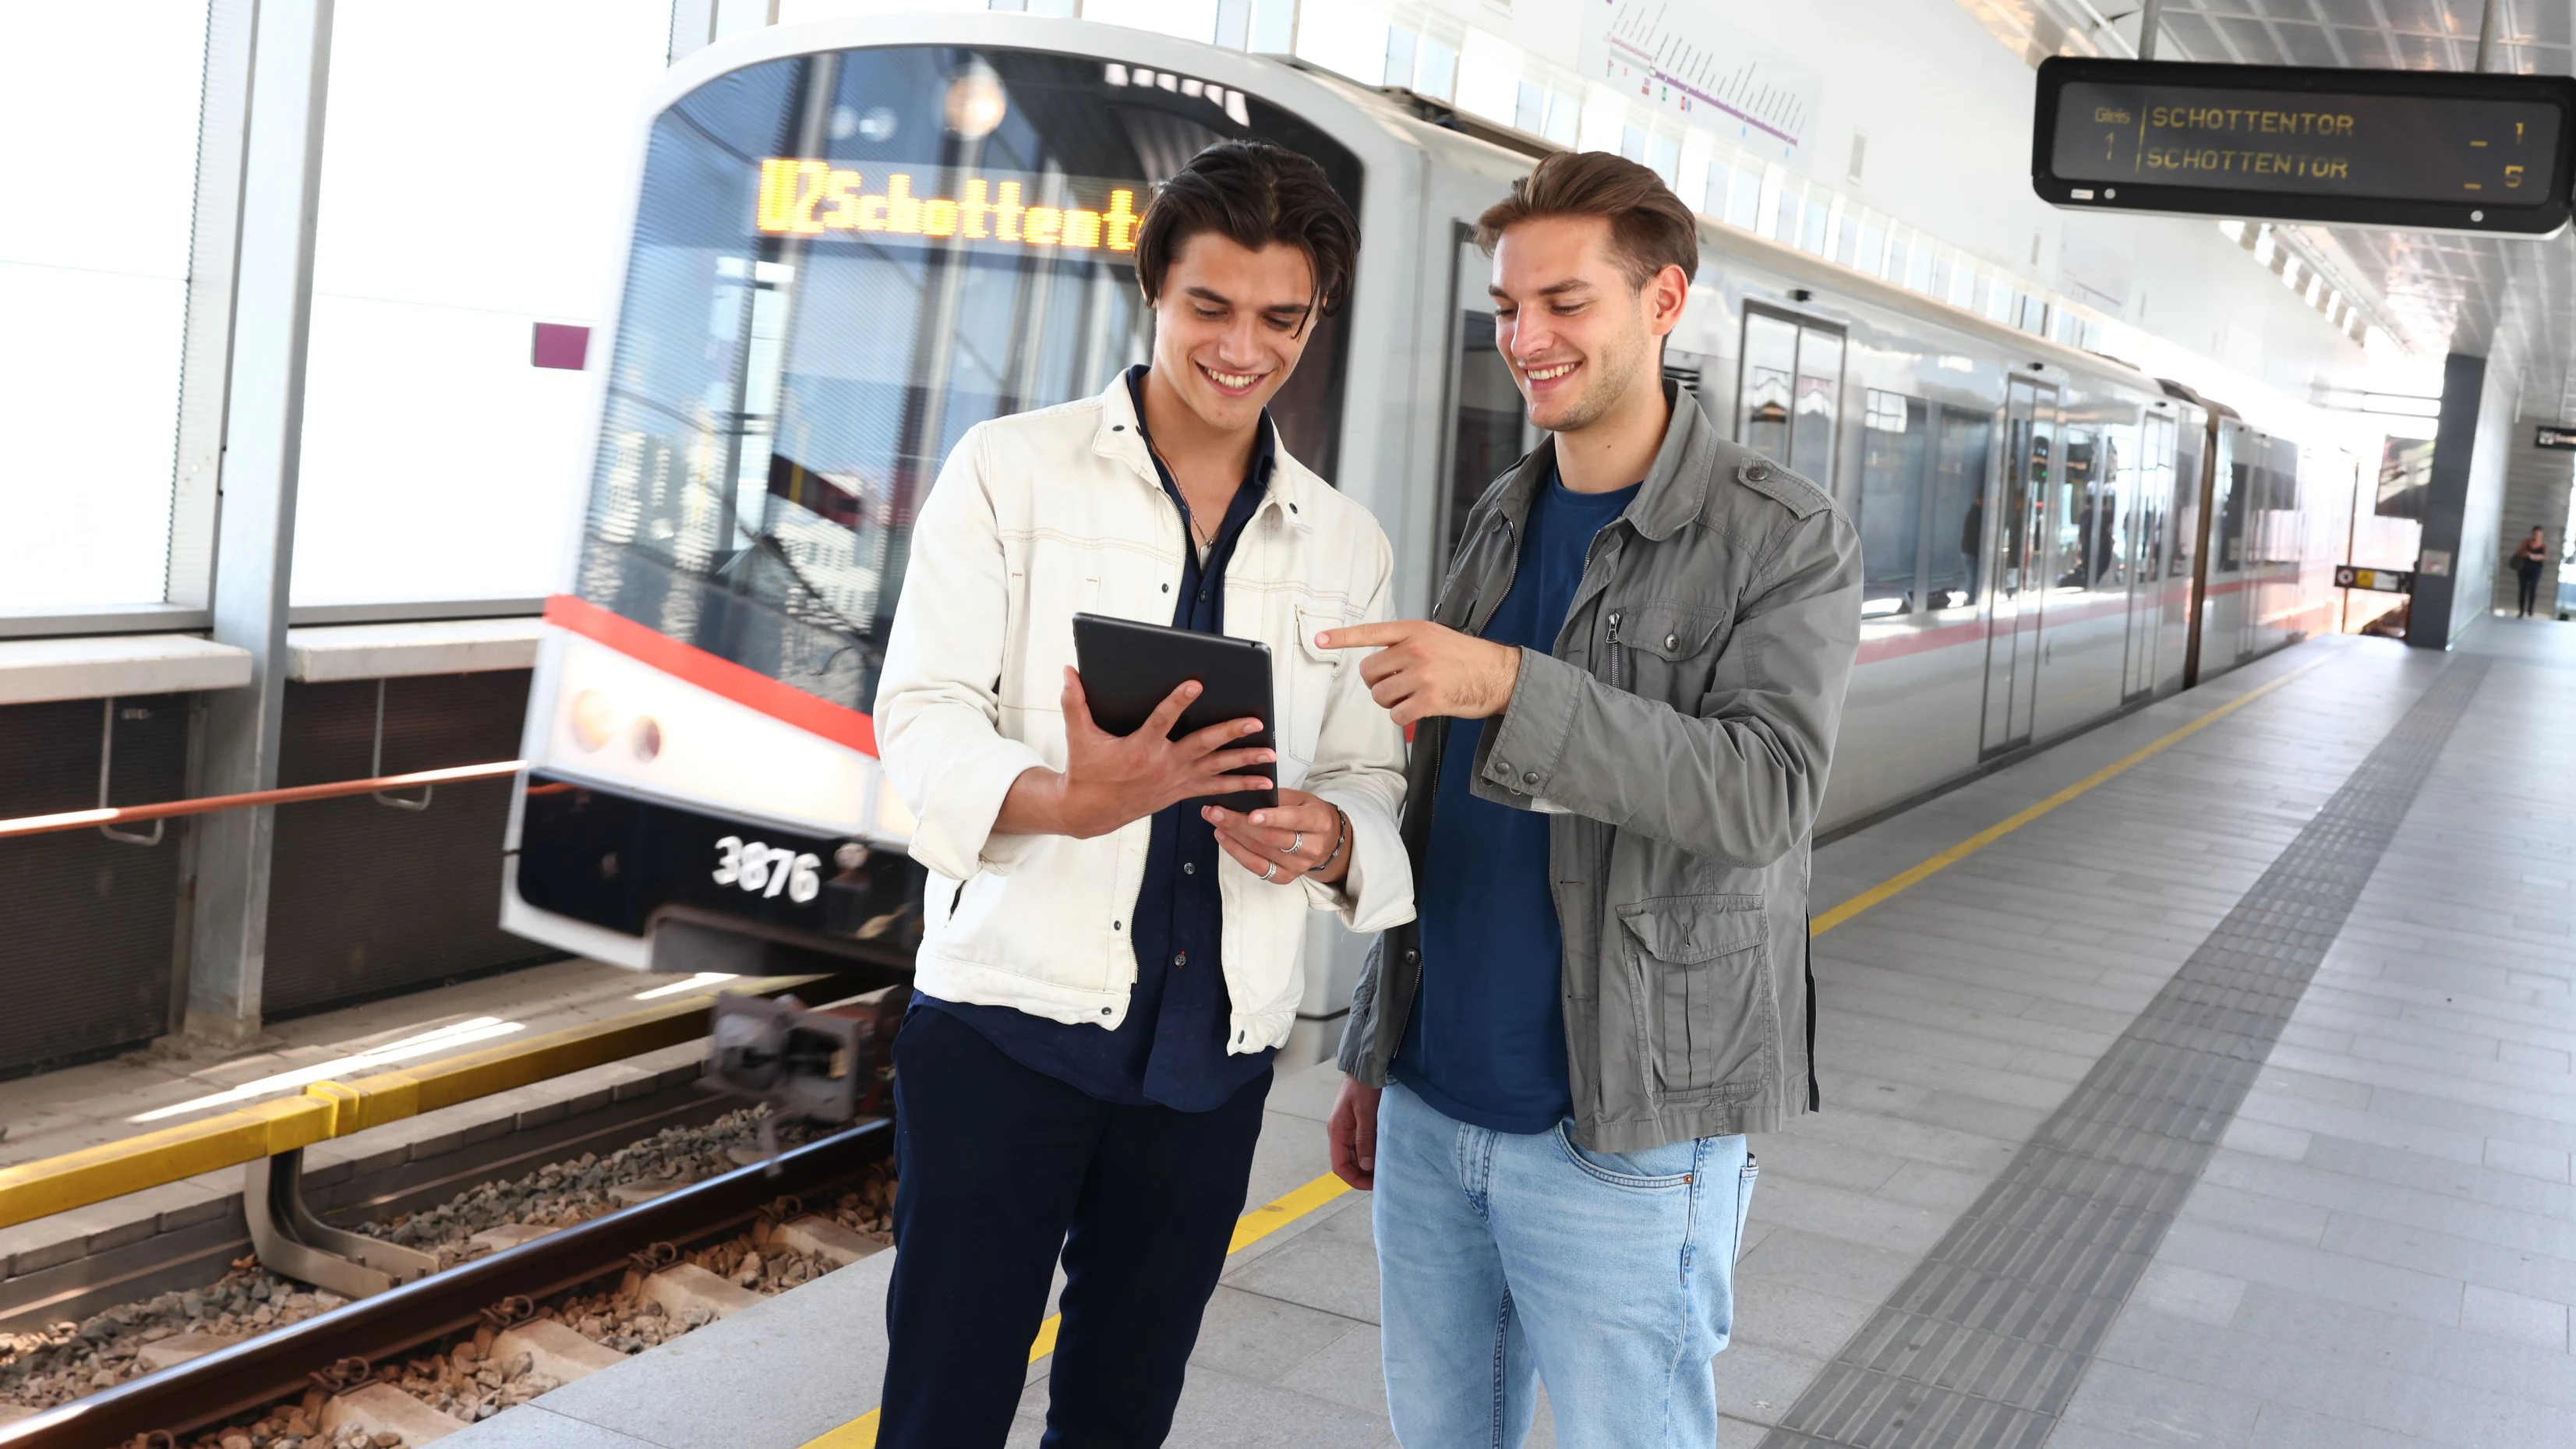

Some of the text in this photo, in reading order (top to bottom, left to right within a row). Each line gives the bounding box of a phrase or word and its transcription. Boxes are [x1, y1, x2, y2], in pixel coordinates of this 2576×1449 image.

[2152, 106, 2354, 136] SCHOTTENTOR
[2106, 131, 2115, 161] 1
[2146, 147, 2524, 187] SCHOTTENTOR 5
[822, 170, 1144, 251] Schottent
[712, 835, 822, 903] 3876
